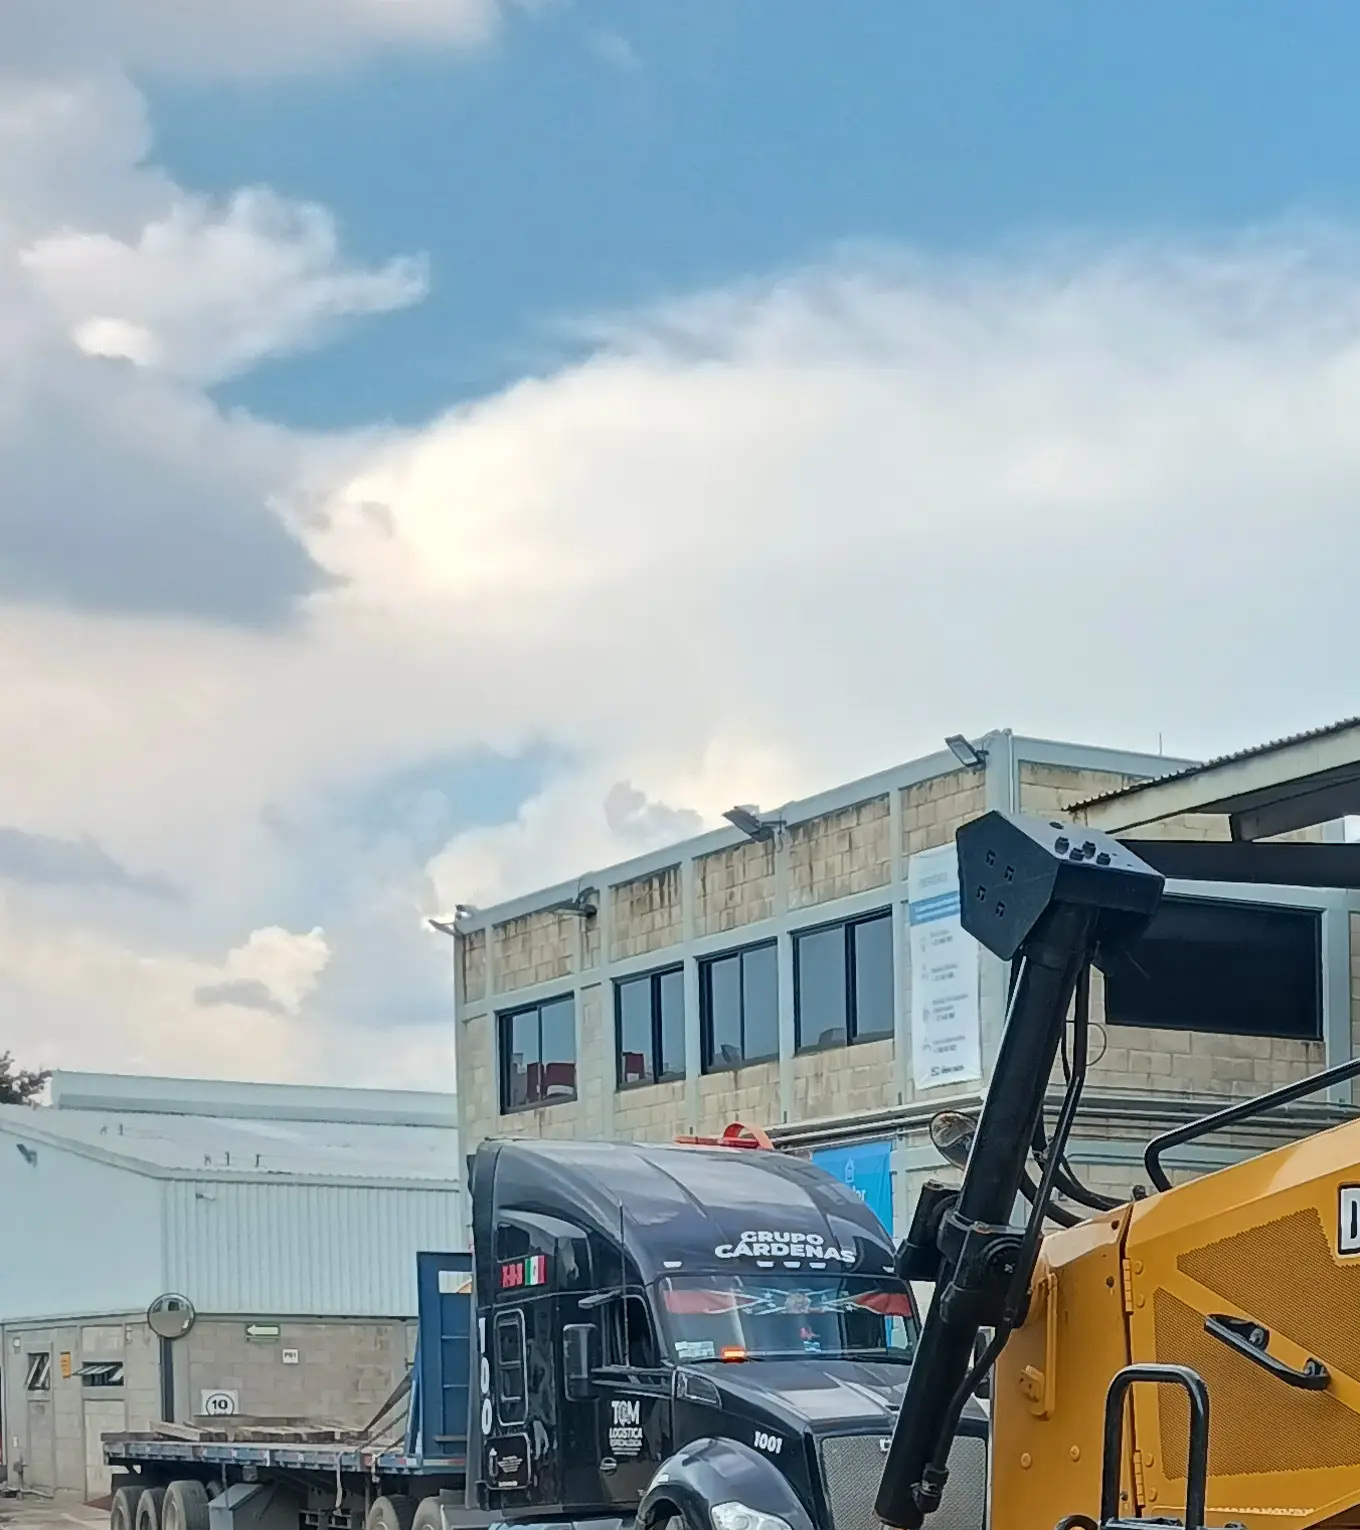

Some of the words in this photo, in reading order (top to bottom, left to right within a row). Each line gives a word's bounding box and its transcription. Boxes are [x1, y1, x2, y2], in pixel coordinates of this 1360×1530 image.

[740, 1230, 825, 1246] GRUPO
[211, 1399, 228, 1410] 10
[754, 1431, 782, 1453] 1001
